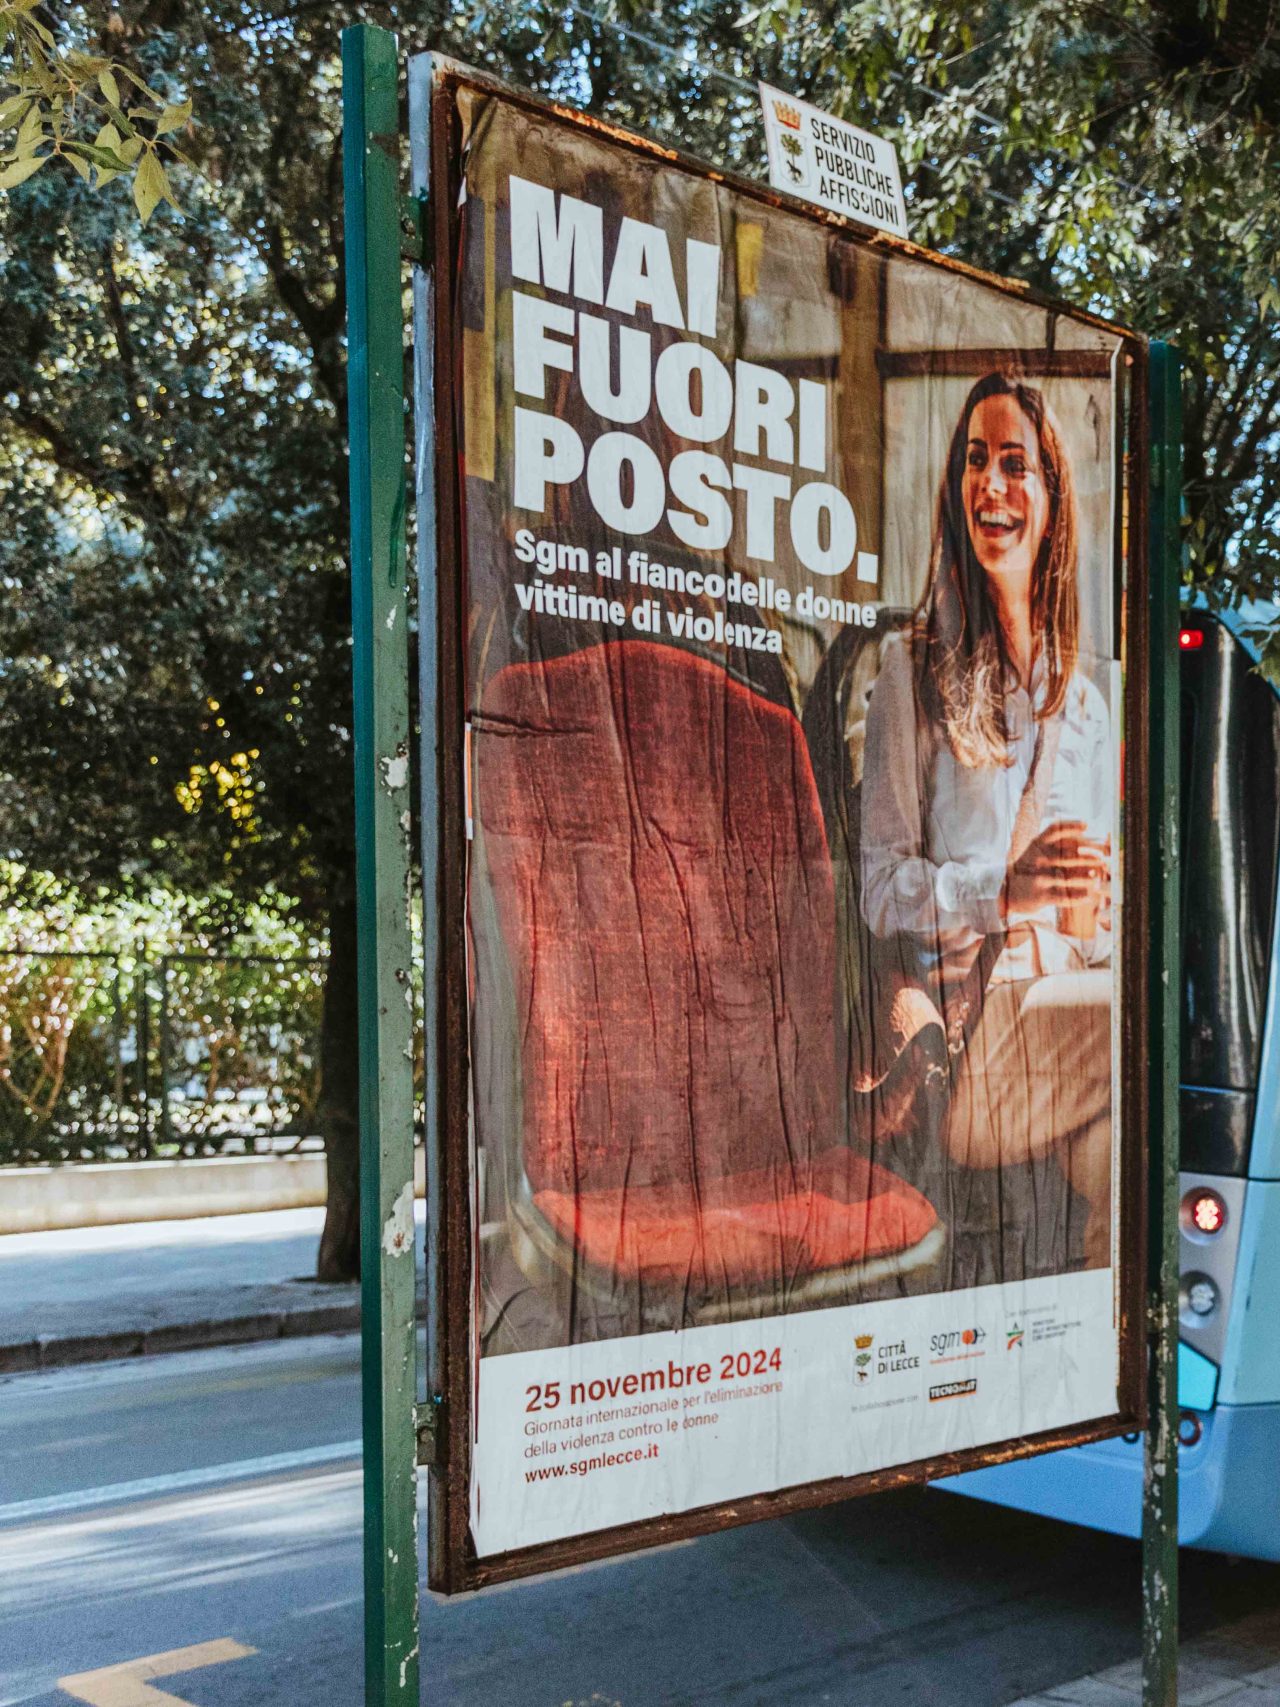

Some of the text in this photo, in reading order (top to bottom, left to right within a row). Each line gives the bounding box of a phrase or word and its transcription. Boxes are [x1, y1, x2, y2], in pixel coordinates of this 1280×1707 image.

[811, 117, 875, 164] SERVIZIO
[815, 145, 894, 198] PUBBLICHE
[820, 175, 899, 226] AFFISSIONI
[509, 175, 721, 338] MAI
[513, 290, 827, 473] FUORI
[514, 406, 879, 583] POSTO.
[514, 528, 588, 576] Sgm
[595, 546, 621, 581] al
[795, 586, 878, 629] donne
[515, 579, 783, 654] vittime di violenza
[878, 1339, 906, 1359] CITTÀ
[878, 1362, 889, 1374] DI
[891, 1356, 920, 1372] LECCE
[930, 1331, 961, 1356] sgm
[525, 1347, 782, 1413] 25 novembre 2024
[524, 1416, 583, 1437] Giornata
[587, 1397, 679, 1425] internazionale
[682, 1394, 701, 1410] per
[524, 1412, 719, 1459] della violenza contro le donne
[525, 1443, 660, 1484] www.sgmlecce.it
